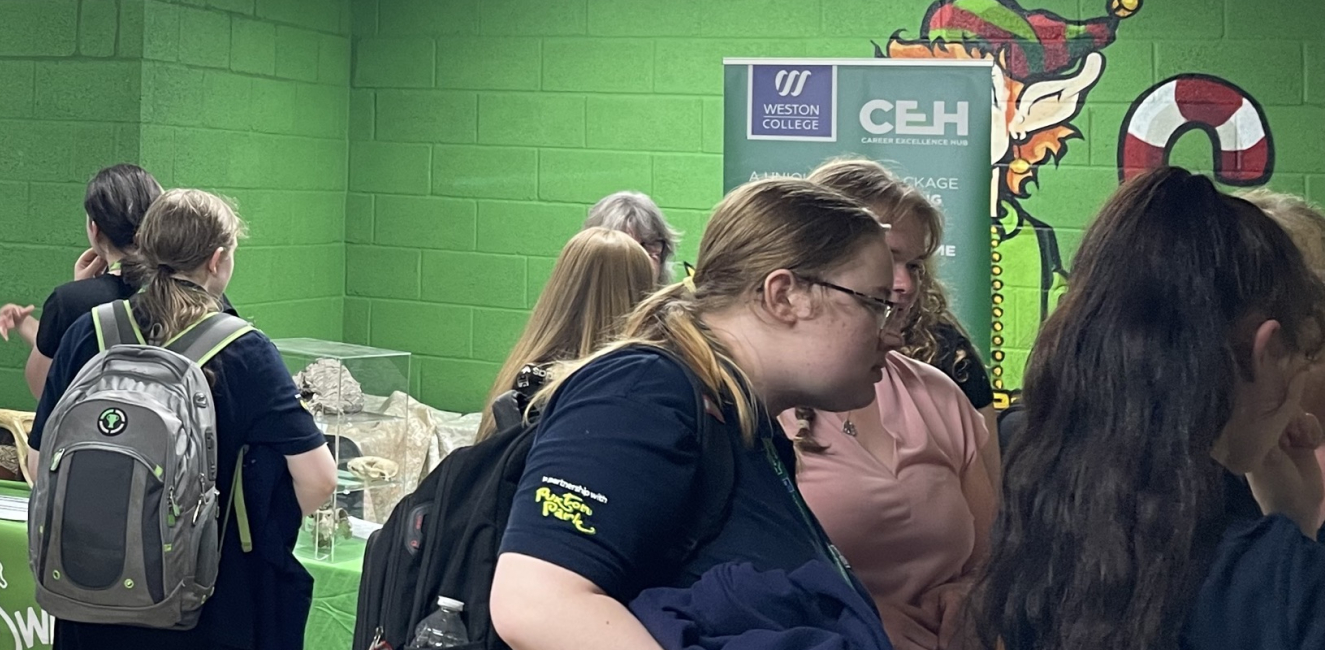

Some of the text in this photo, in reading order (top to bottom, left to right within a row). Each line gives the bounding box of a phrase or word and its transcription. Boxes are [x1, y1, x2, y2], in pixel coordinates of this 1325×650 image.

[763, 103, 820, 116] WESTON
[762, 118, 819, 130] COLLEGE
[859, 99, 969, 136] CEH
[748, 170, 759, 182] A
[590, 491, 608, 504] with
[542, 500, 596, 535] Park
